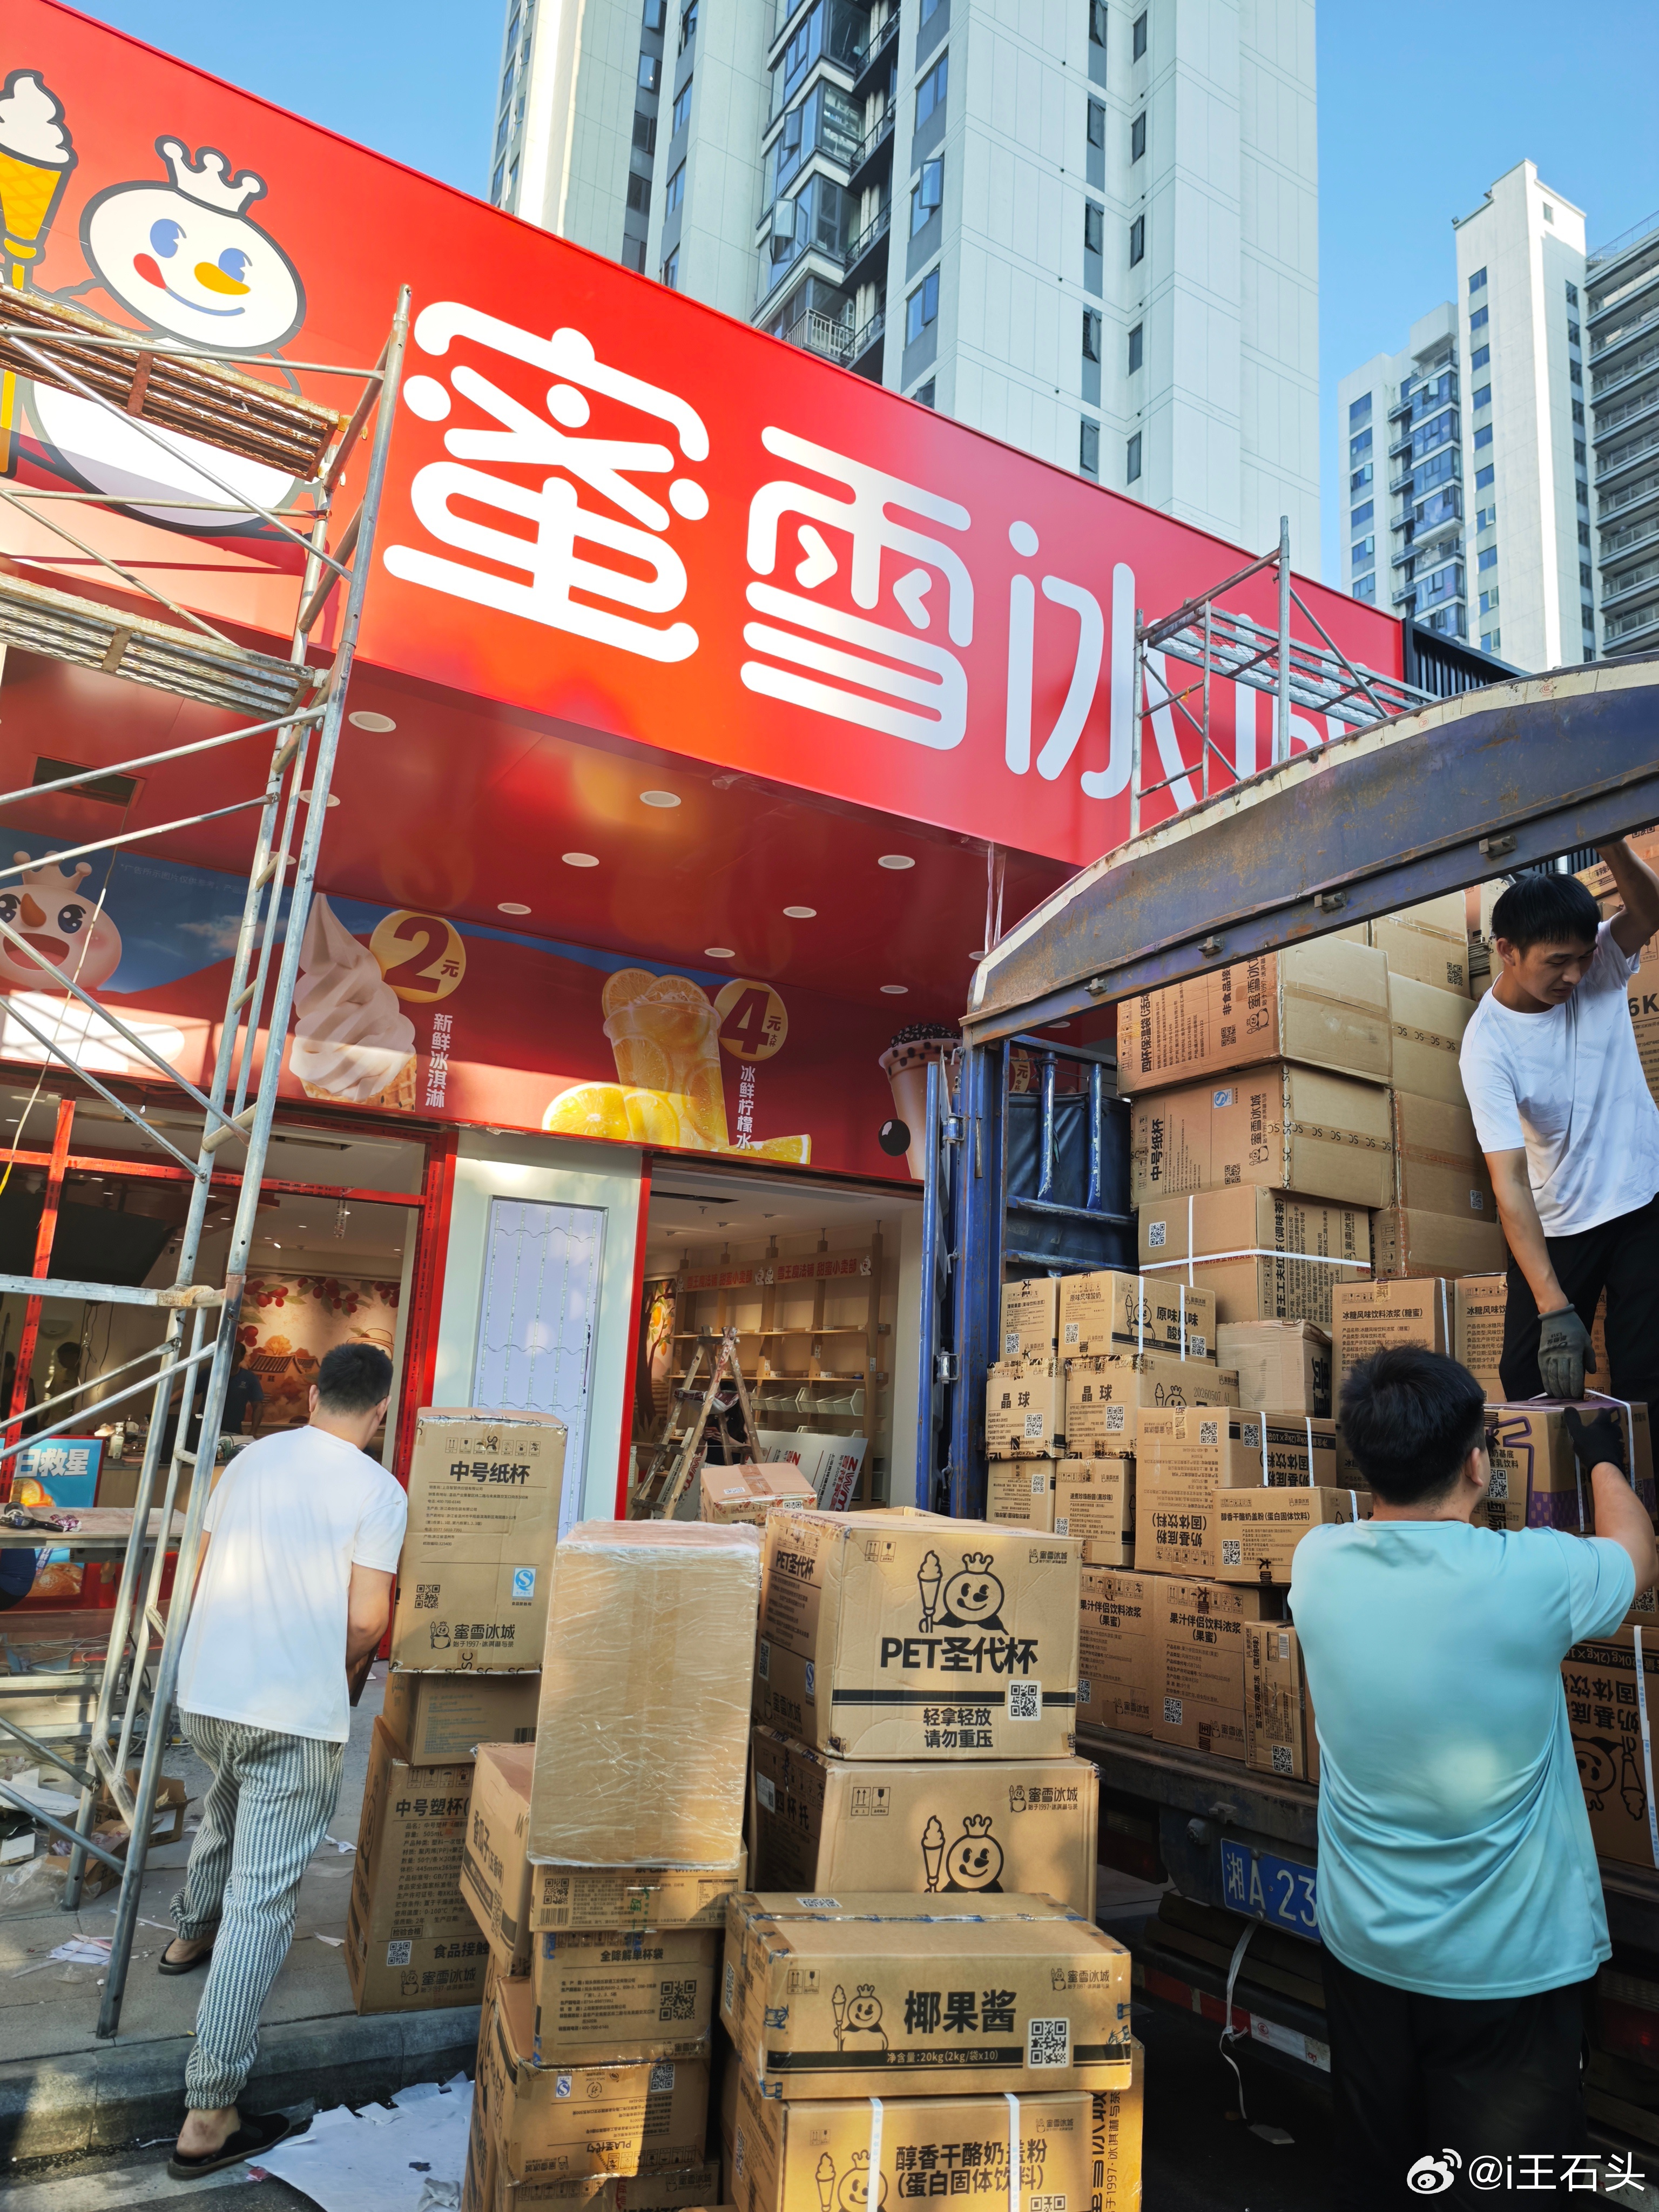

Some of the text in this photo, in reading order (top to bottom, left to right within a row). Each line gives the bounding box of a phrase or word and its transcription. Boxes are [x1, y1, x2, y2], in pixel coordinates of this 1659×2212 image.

[1222, 965, 1232, 1015] 非食品接
[768, 1034, 778, 1047] 大杯
[425, 1013, 453, 1108] 新鲜冰淇淋
[1016, 1064, 1028, 1079] 元
[736, 1065, 756, 1150] 冰鲜柠檬水
[1251, 1094, 1262, 1145] 蜜雪冰城
[1150, 1118, 1164, 1181] 中号纸杯
[817, 1259, 857, 1276] 甜蜜小卖部
[1070, 1293, 1101, 1301] 原味风味酸奶
[1343, 1308, 1423, 1320] 冰糖风味饮料浓浆(糖蜜)
[1467, 1305, 1506, 1314] 冰糖风味饮
[1193, 1386, 1222, 1401] 20260507
[450, 1461, 531, 1484] 中号纸杯
[1070, 1493, 1113, 1501] 速煮珍珠粉圆(黑珍珠)
[1152, 1512, 1207, 1530] (固体饮料)
[1221, 1512, 1310, 1521] 醇香干酪奶盖粉(蛋白固体饮料)
[1156, 1529, 1203, 1547] 奶基底粉
[1039, 1551, 1068, 1560] 蜜雪冰城
[776, 1550, 815, 1581] PET圣代杯
[1080, 1600, 1142, 1617] 果汁伴侣饮料浓浆
[1100, 1614, 1121, 1628] (果蜜)
[1170, 1613, 1241, 1634] 果汁伴侣饮料浓浆
[454, 1623, 515, 1640] 蜜雪冰城
[1192, 1629, 1217, 1644] (果蜜)
[881, 1636, 1038, 1674] PET圣代杯
[1252, 1636, 1262, 1729] 雪王可吸果冻(蜜桃味)
[1124, 1701, 1150, 1715] 蜜雪冰城
[923, 1708, 992, 1727] 轻拿轻放
[1567, 1701, 1639, 1734] 奶基底
[924, 1729, 993, 1748] 请勿重压
[1028, 1786, 1078, 1803] 蜜雪冰城
[396, 1797, 469, 1817] 中号塑杯(
[393, 1927, 421, 1937] 检验合格
[434, 1941, 489, 1959] 食品接触
[601, 1947, 664, 1963] 全降解单杯袋
[422, 1967, 476, 1985] 蜜雪冰城
[1067, 1968, 1110, 1985] 蜜雪冰城
[904, 1989, 1018, 2035] 椰果酱
[886, 2049, 999, 2065] 净含量:20kg(2kg/袋x10)
[1046, 2118, 1074, 2128] 蜜雪冰城
[586, 2140, 631, 2153] PLA圣代勺
[895, 2138, 1048, 2172] 醇香干酪奶盖粉
[1105, 2092, 1122, 2212] 于1997·冰淇淋与茶
[525, 2161, 557, 2173] 蜜雪冰城
[898, 2164, 1044, 2199] (蛋白固体饮料)
